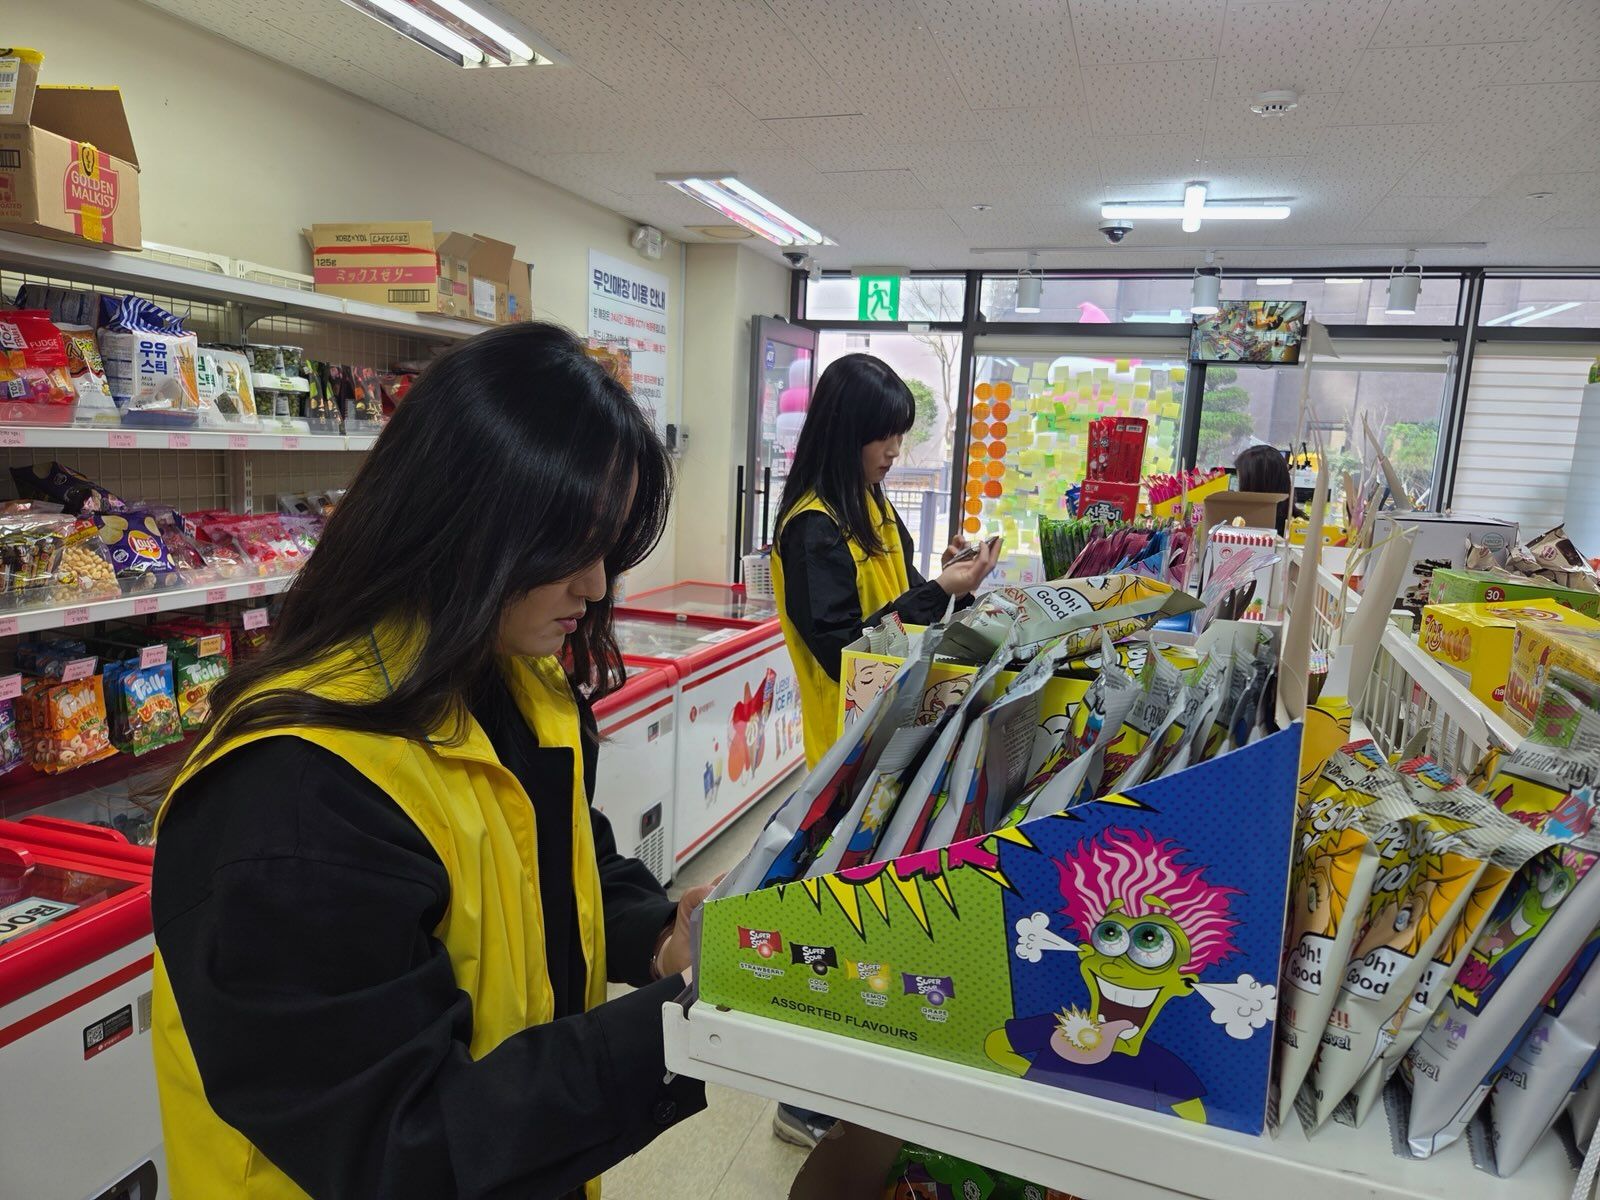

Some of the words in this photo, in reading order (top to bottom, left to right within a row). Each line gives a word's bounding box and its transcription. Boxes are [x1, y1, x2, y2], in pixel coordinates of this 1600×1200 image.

[71, 171, 114, 195] GOLDEN
[71, 185, 115, 209] MALKIST
[316, 258, 337, 267] 125g
[593, 268, 631, 299] 무인매장
[631, 281, 649, 305] 이용
[649, 287, 665, 310] 안내
[0, 324, 12, 347] TOP
[29, 338, 59, 348] FUDGE
[140, 340, 168, 359] 우유
[140, 359, 168, 375] 스틱
[9, 381, 19, 397] TOP
[1058, 590, 1082, 613] Oh!
[1485, 589, 1501, 601] 30
[1036, 590, 1069, 621] Good
[186, 663, 226, 684] Trolli
[131, 674, 167, 701] Trolli
[59, 688, 96, 719] Trolli
[749, 930, 771, 940] SUPER
[751, 939, 769, 949] SOUR
[802, 946, 826, 956] SUPER
[804, 954, 823, 964] SOUR
[1300, 942, 1321, 964] Oh!
[740, 963, 784, 976] STRAWBERRY
[857, 962, 881, 972] SUPER
[1290, 960, 1322, 986] Good
[1363, 953, 1396, 978] Oh!
[809, 978, 828, 987] COLA
[859, 971, 880, 980] SOUR
[916, 976, 942, 987] SUPER
[1346, 968, 1390, 996] Good
[861, 992, 888, 1001] LEMON
[918, 985, 939, 994] SOUR
[770, 996, 842, 1022] ASSORTED
[844, 1014, 919, 1042] FLAVOURS
[922, 1007, 948, 1016] GRAPE
